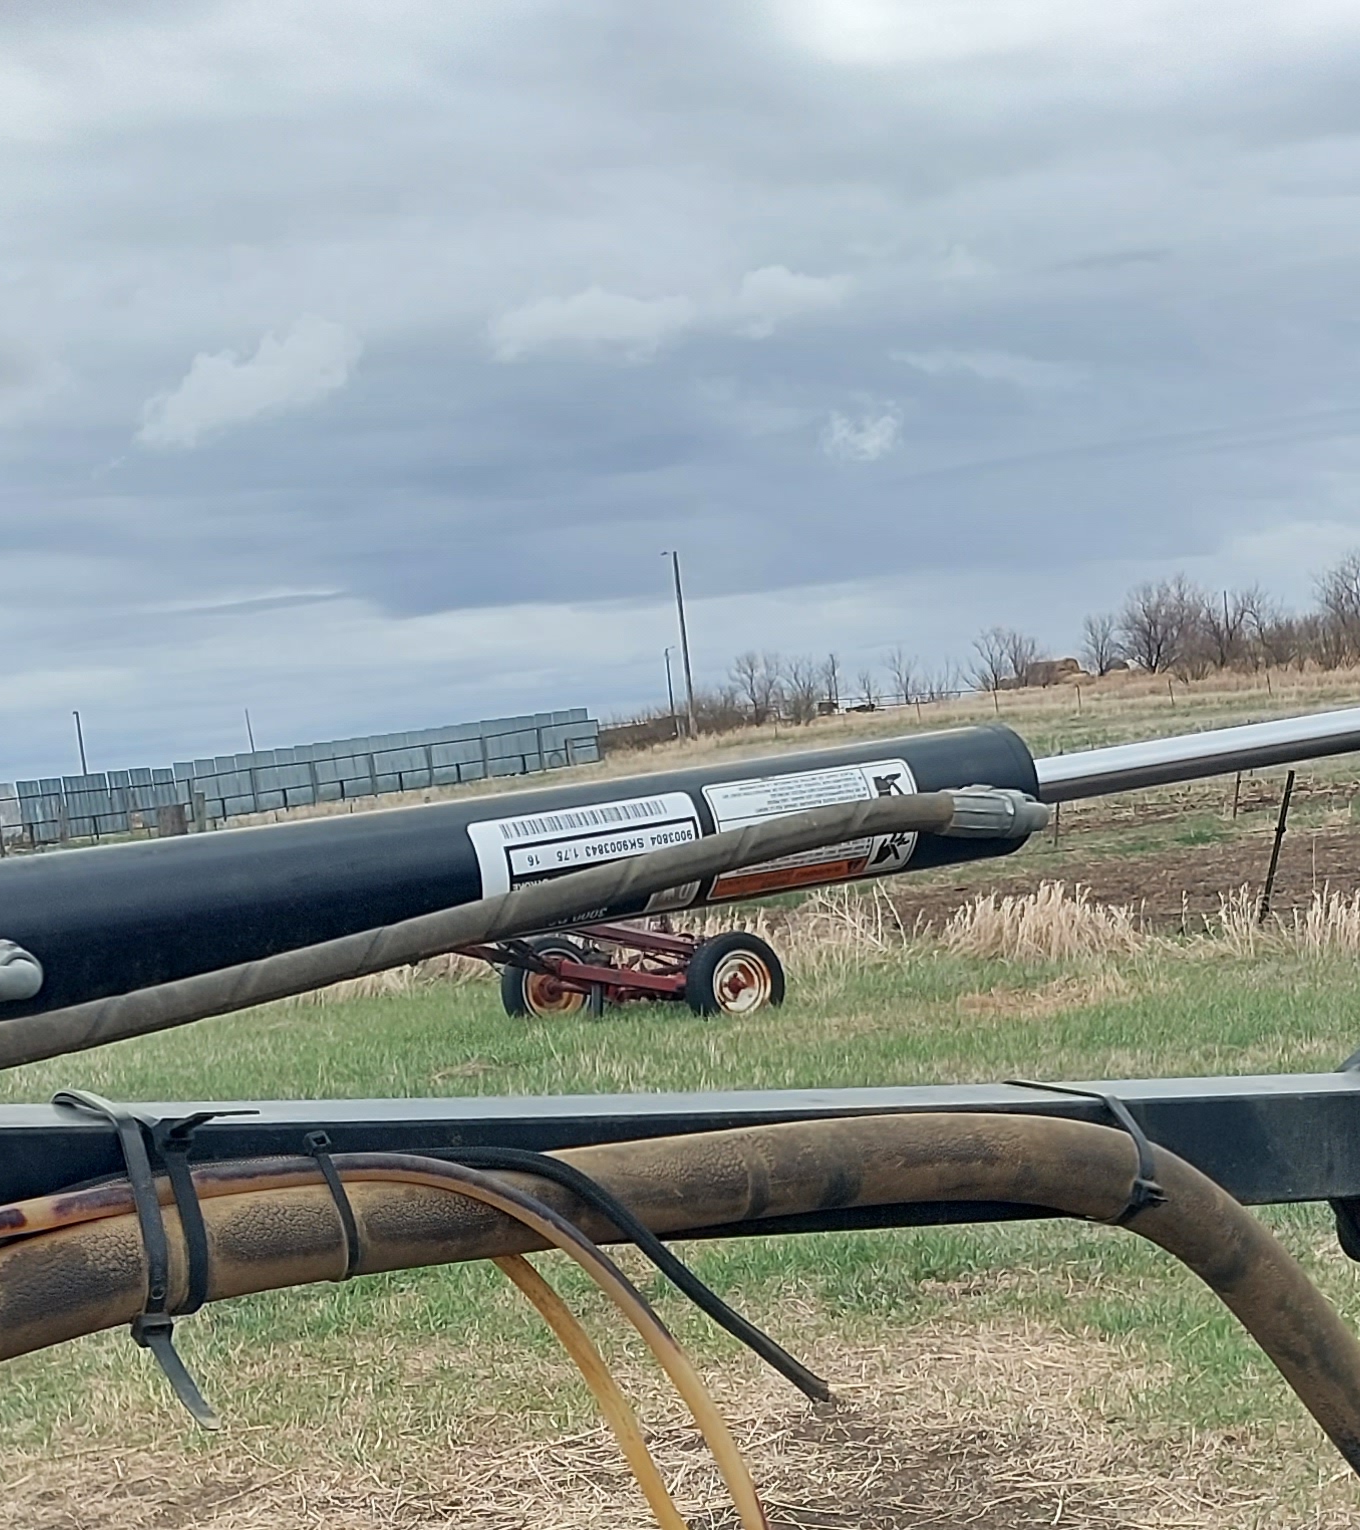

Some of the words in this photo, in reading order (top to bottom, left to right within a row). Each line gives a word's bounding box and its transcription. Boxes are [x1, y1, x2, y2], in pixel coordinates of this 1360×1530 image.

[650, 829, 692, 846] 9003804
[586, 837, 644, 857] SK9003843
[527, 854, 540, 866] 16
[556, 848, 579, 862] 1.75
